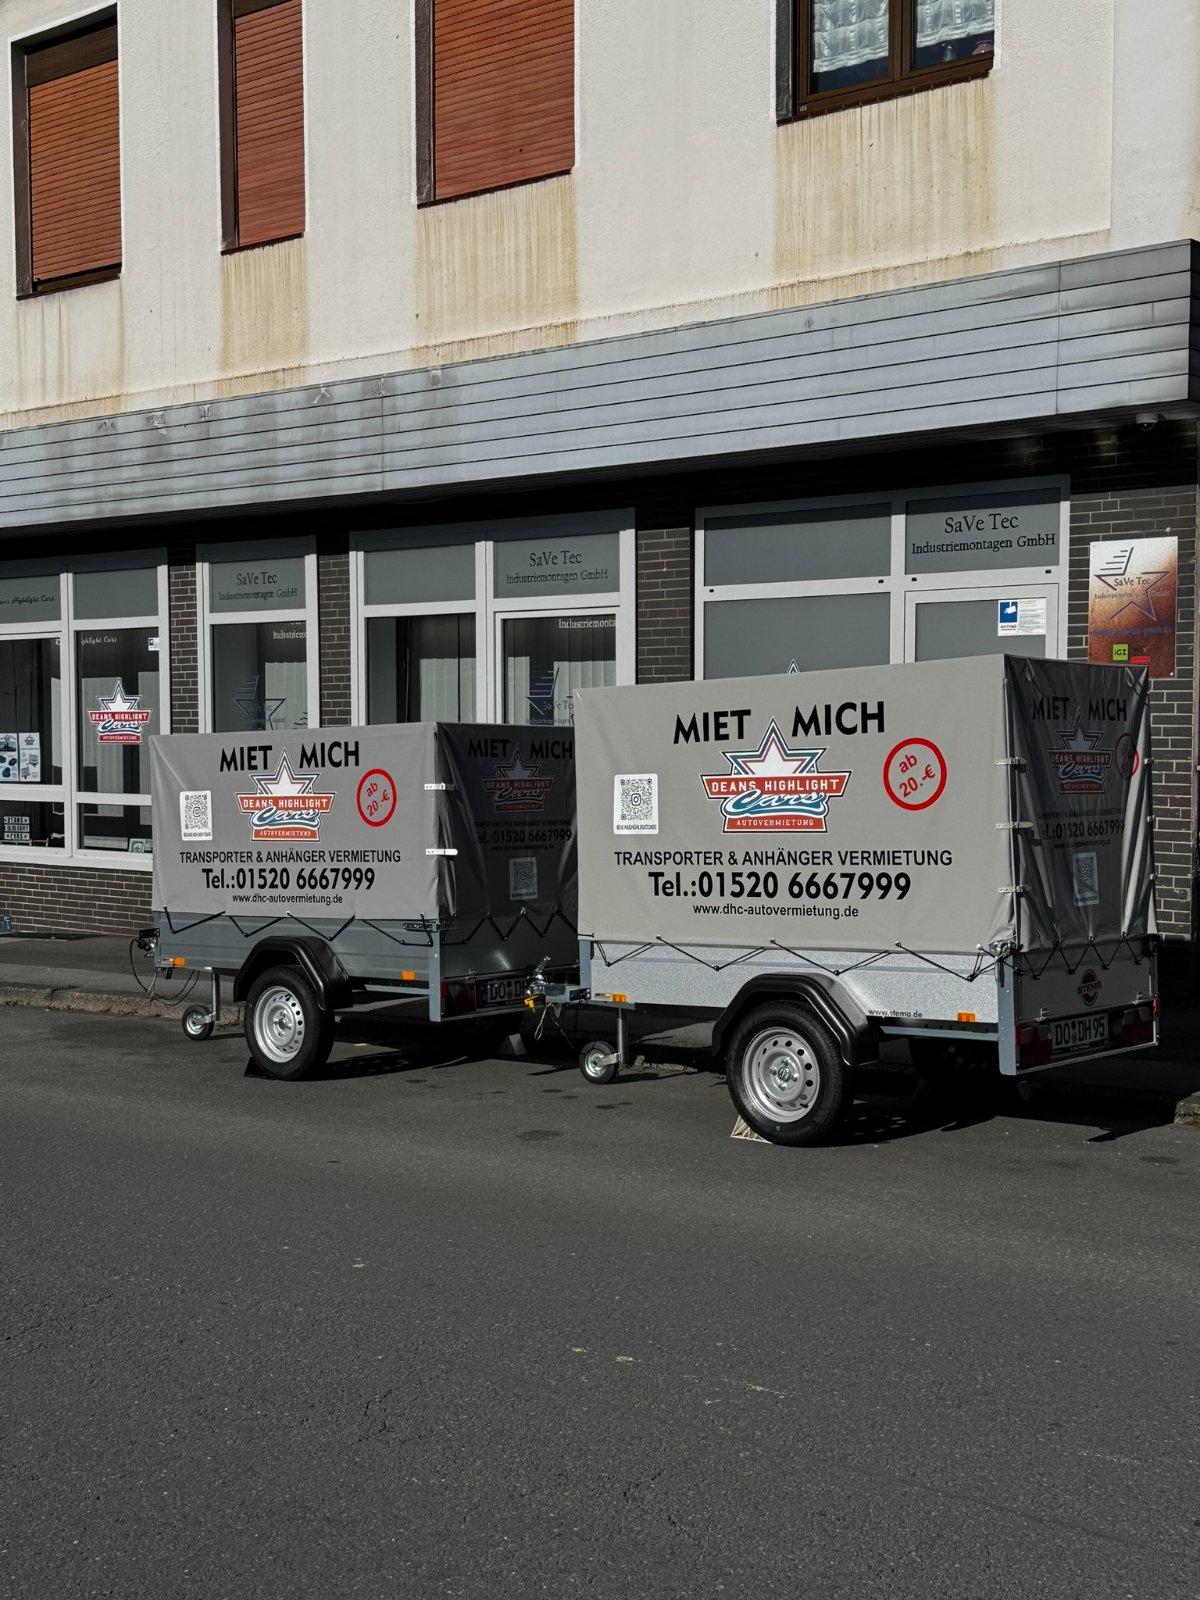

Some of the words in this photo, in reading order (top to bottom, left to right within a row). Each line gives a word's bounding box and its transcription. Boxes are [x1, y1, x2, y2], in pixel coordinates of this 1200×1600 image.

[944, 514, 985, 534] SaVe
[989, 512, 1020, 530] Tec
[911, 539, 1013, 556] Industriemontagen
[1016, 533, 1056, 549] GmbH
[529, 551, 558, 567] SaVe
[560, 550, 582, 565] Tec
[236, 571, 259, 586] SaVe
[260, 571, 278, 585] Tec
[506, 571, 577, 585] Industriemontagen
[580, 568, 608, 581] GmbH
[1113, 577, 1135, 587] SaVe
[1136, 576, 1151, 586] Tec
[276, 587, 297, 598] GmbH
[1032, 696, 1069, 721] MIET
[1088, 698, 1127, 722] MICH
[673, 708, 752, 745] MIET
[791, 700, 885, 738] MICH
[219, 744, 272, 773] MIET
[299, 740, 360, 770] MICH
[467, 738, 510, 758] MIET
[530, 740, 573, 760] MICH
[898, 752, 918, 774] ab
[365, 782, 379, 798] ab
[711, 780, 757, 793] DEANS
[764, 778, 839, 792] HIGHLIGHT
[243, 798, 274, 810] DEANS
[278, 798, 328, 809] HIGHLIGHT
[724, 788, 827, 814] Cars
[252, 806, 320, 828] Cars
[736, 818, 814, 828] AUTOVERMIETUNG
[476, 829, 526, 844] el.:01520
[528, 828, 573, 842] 6667999
[179, 851, 253, 864] TRANSPORTER
[256, 851, 264, 864] &
[265, 848, 325, 864] ANHÄNGER
[328, 849, 401, 864] VERMIETUNG
[614, 850, 723, 866] TRANSPORTER
[728, 850, 739, 866] &
[742, 847, 832, 866] ANHÄNGER
[837, 849, 953, 866] VERMIETUNG
[202, 868, 290, 891] Tel.:01520
[296, 868, 375, 891] 6667999
[647, 870, 778, 899] Tel.:01520
[788, 871, 911, 900] 6667999
[232, 893, 343, 906] www.dhc-autovermietung.de
[693, 902, 859, 920] www.dhc-autovermietung.de
[1055, 1023, 1071, 1046] DO
[1078, 1019, 1092, 1043] DH
[1094, 1016, 1106, 1039] 95
